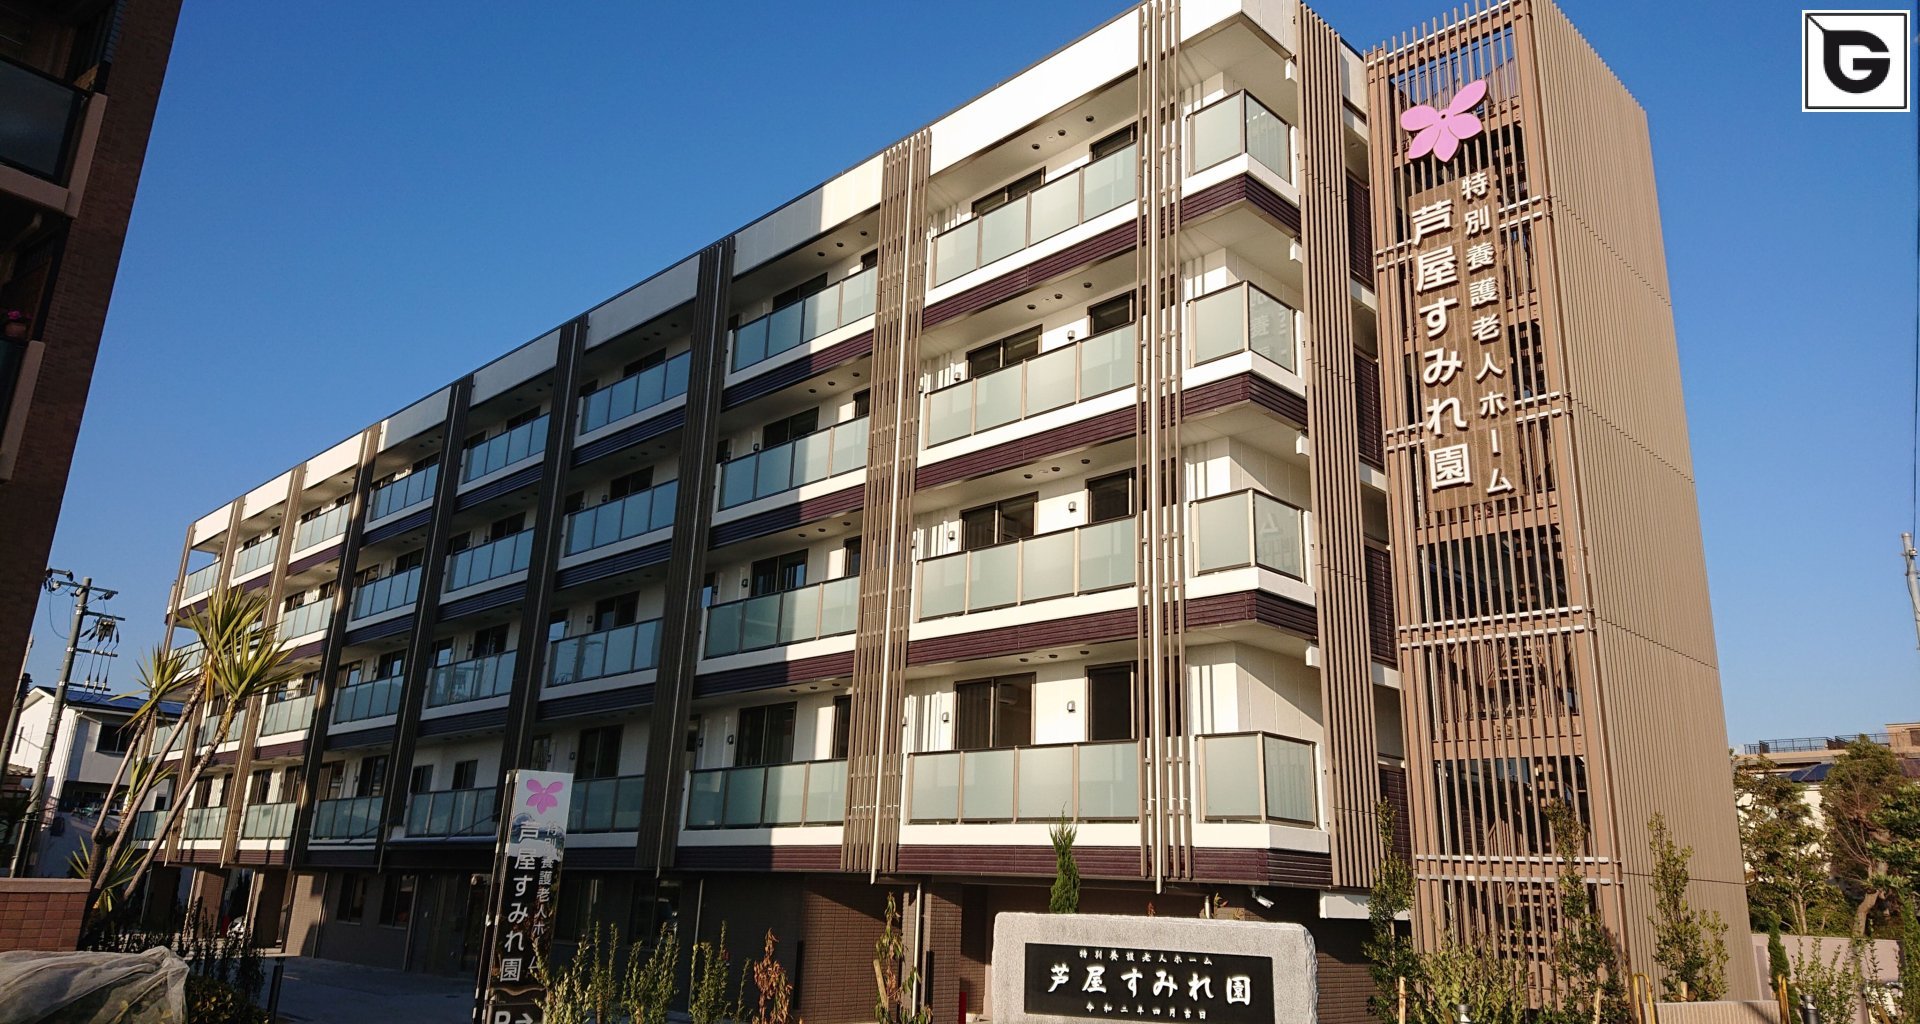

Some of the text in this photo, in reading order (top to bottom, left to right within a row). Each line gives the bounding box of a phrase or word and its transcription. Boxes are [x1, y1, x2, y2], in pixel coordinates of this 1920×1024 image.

[1411, 198, 1471, 490] 芦屋すみれ園
[1461, 171, 1513, 495] 特別養護老人ホーム
[1079, 948, 1213, 966] 特別養護老人ホーム
[1048, 963, 1251, 1006] 芦屋すみれ園
[1086, 1001, 1206, 1019] 令和二年四月吉日
